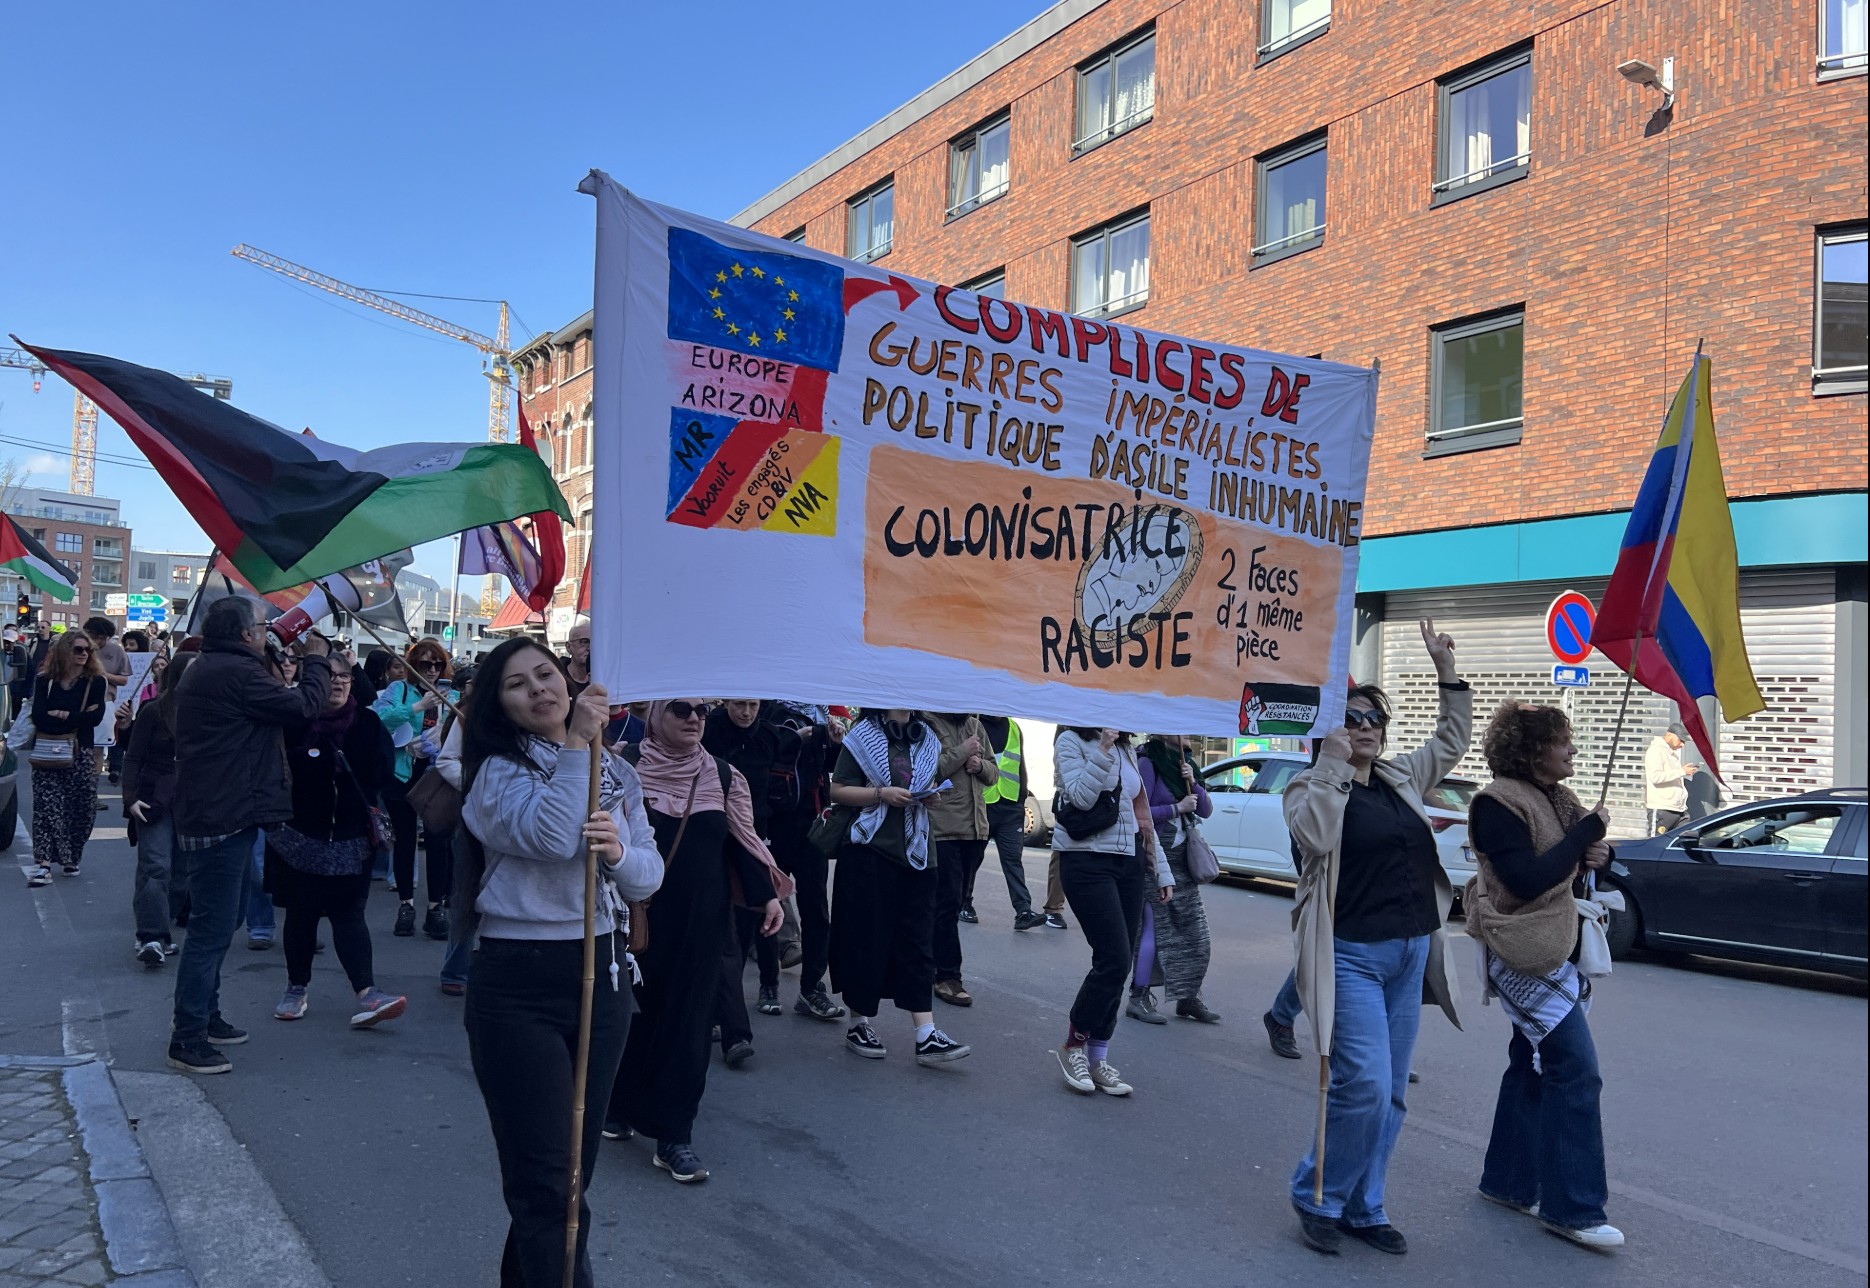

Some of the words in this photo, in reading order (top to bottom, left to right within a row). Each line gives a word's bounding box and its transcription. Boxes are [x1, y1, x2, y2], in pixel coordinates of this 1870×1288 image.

[691, 345, 793, 384] EUROPE
[868, 320, 1064, 413] GUERRES
[932, 283, 1248, 411] COMPLICES
[1261, 365, 1310, 425] DE
[674, 420, 715, 472] MR
[727, 498, 751, 525] Les
[748, 440, 790, 497] engagés
[756, 467, 793, 521] CD&V
[784, 481, 829, 528] NVA
[1217, 547, 1237, 592] 2
[1248, 545, 1299, 597] Faces
[1257, 597, 1303, 632] même
[1040, 610, 1194, 674] RACISTE
[1236, 629, 1281, 668] pièce
[1268, 703, 1313, 712] COORDINATION
